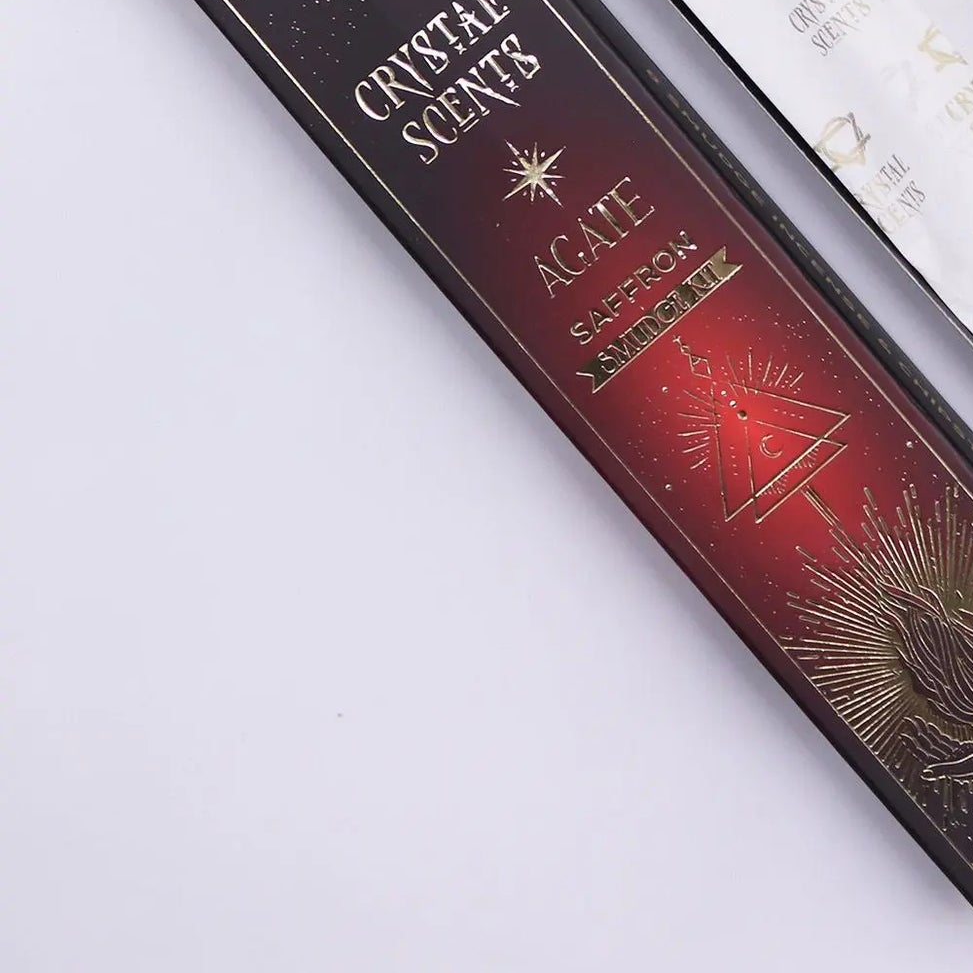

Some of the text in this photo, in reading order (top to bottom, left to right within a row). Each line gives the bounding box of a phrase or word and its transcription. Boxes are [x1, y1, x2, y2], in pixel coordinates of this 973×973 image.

[401, 33, 542, 165] SCENTS
[533, 176, 655, 299] AGATE
[570, 230, 698, 345] SAFFRON
[771, 213, 870, 330] INCENSE
[597, 260, 724, 375] SMUDGE KIT
